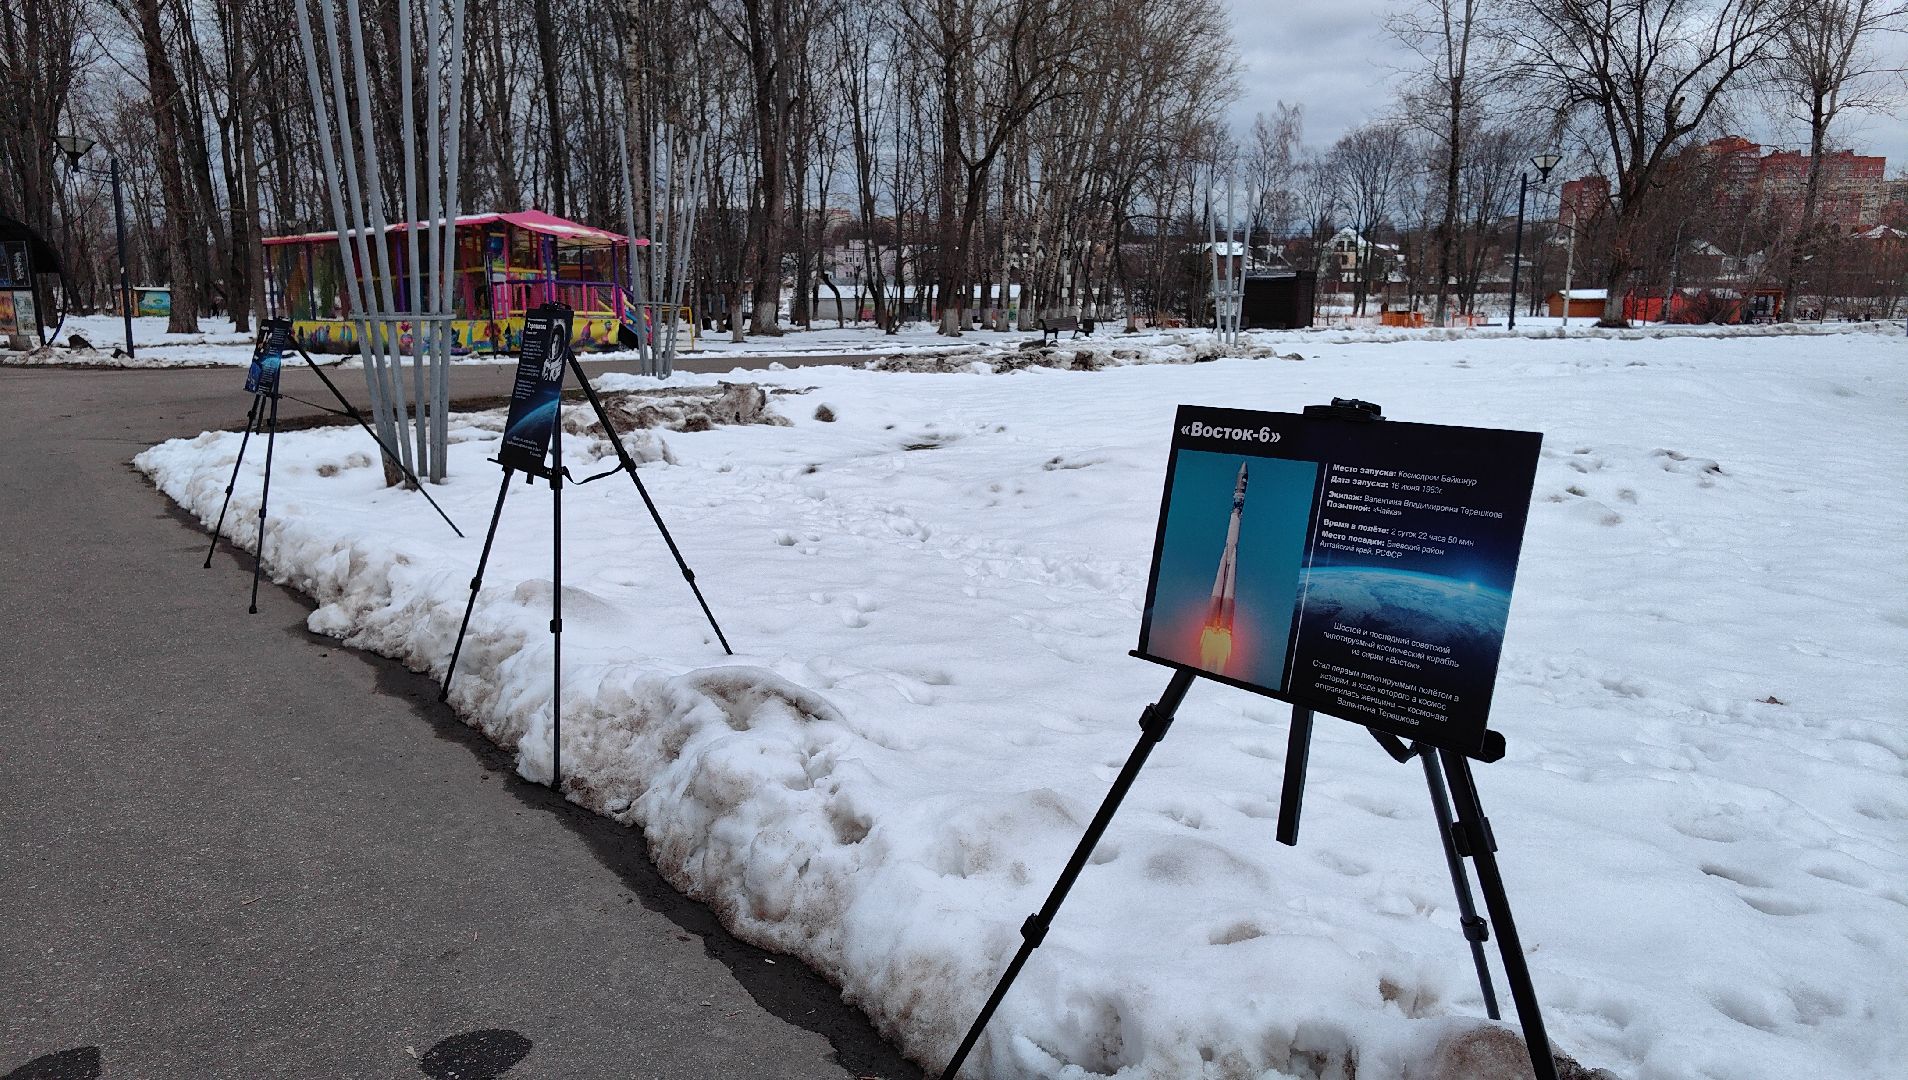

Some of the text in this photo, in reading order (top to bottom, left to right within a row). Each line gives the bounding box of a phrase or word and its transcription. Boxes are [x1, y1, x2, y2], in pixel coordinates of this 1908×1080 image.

[1181, 422, 1281, 443] «Восток-6»
[1331, 476, 1350, 484] Дата
[1352, 479, 1389, 488] запуска:
[1333, 464, 1477, 486] Место запуска: Космодром Байконур
[1327, 500, 1402, 516] Позывной: «Чайка»
[1328, 490, 1503, 519] Экипаж: Валентина Владимировна Терешкова
[1322, 531, 1346, 540] Место
[1348, 536, 1385, 547] посадки:
[1422, 547, 1445, 556] район
[1324, 519, 1350, 528] Время
[1358, 524, 1389, 534] полёте:
[1418, 532, 1428, 540] 22
[1448, 536, 1458, 544] 50
[1459, 539, 1474, 547] мин
[1320, 540, 1354, 552] Алтайский
[1375, 549, 1403, 559] РСФСР
[1324, 632, 1459, 668] пилотируемый космический корабль
[1334, 622, 1362, 635] Шестой
[1370, 632, 1410, 646] последний
[1411, 640, 1450, 654] советский
[1362, 651, 1384, 661] серии
[1313, 660, 1330, 670] Стал
[1332, 665, 1360, 678] первым
[1361, 672, 1417, 691] пилотируемым
[1419, 687, 1452, 700] полётом
[1315, 683, 1360, 699] отправилась
[1408, 707, 1448, 722] космонавт
[1358, 683, 1376, 692] ходе
[1378, 688, 1410, 701] которого
[1419, 698, 1447, 711] космос
[1337, 697, 1420, 726] Валентина Терешкова
